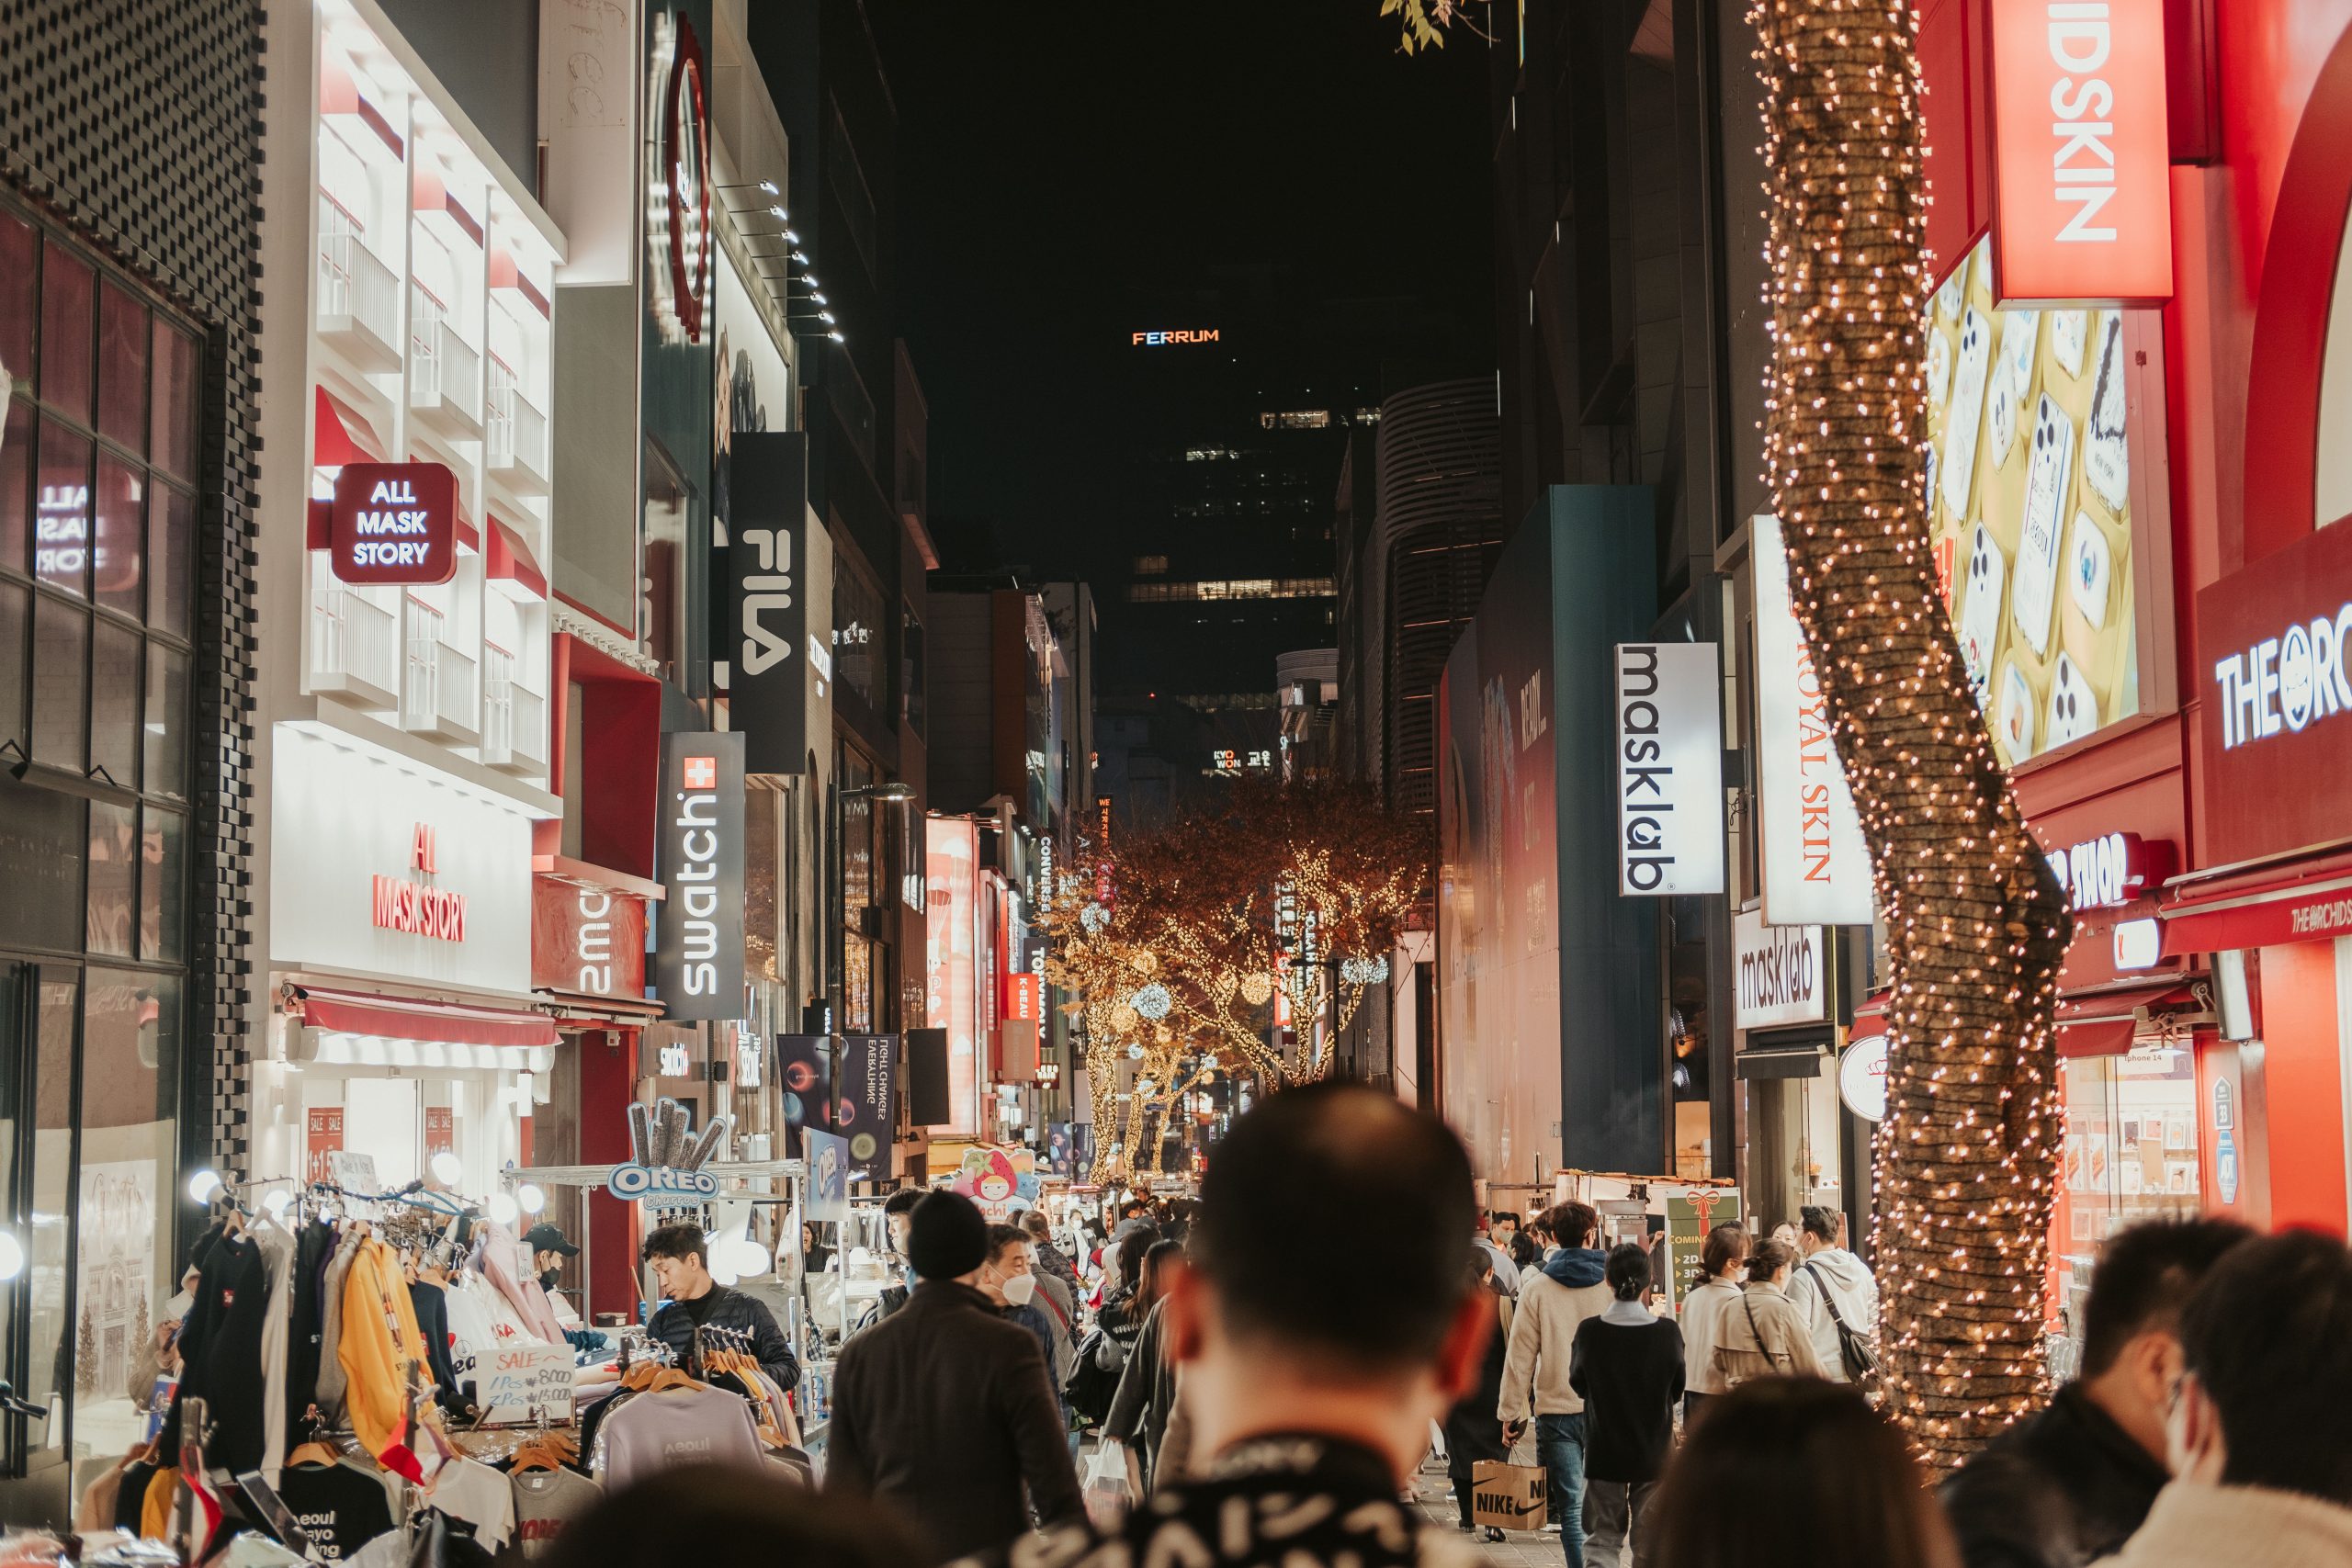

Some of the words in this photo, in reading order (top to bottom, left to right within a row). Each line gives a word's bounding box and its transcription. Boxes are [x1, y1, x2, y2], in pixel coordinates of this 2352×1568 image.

[1133, 330, 1219, 345] FERRUM
[370, 479, 416, 504] ALL
[356, 511, 428, 535] MASK
[353, 542, 430, 568] STORY
[742, 529, 792, 675] FILA
[1214, 750, 1235, 761] KYO
[1216, 759, 1241, 769] WON
[1623, 646, 1675, 891] masklab
[1099, 798, 1110, 807] WE
[1801, 784, 1831, 885] SKIN
[410, 822, 440, 874] ALL
[2070, 833, 2127, 910] SHOP
[677, 795, 718, 996] swatch
[373, 874, 422, 934] MASK
[421, 885, 469, 942] STORY
[1742, 927, 1813, 1010] masklab
[311, 1117, 323, 1132] SALE
[328, 1116, 341, 1131] SALE
[427, 1115, 438, 1129] SALE
[441, 1115, 451, 1129] SALE
[616, 1166, 717, 1193] OREO
[646, 1195, 699, 1208] Churros
[978, 1202, 1006, 1217] ochi
[1683, 1256, 1699, 1264] 2D
[496, 1352, 542, 1371] SALE
[1476, 1493, 1513, 1515] NIKE
